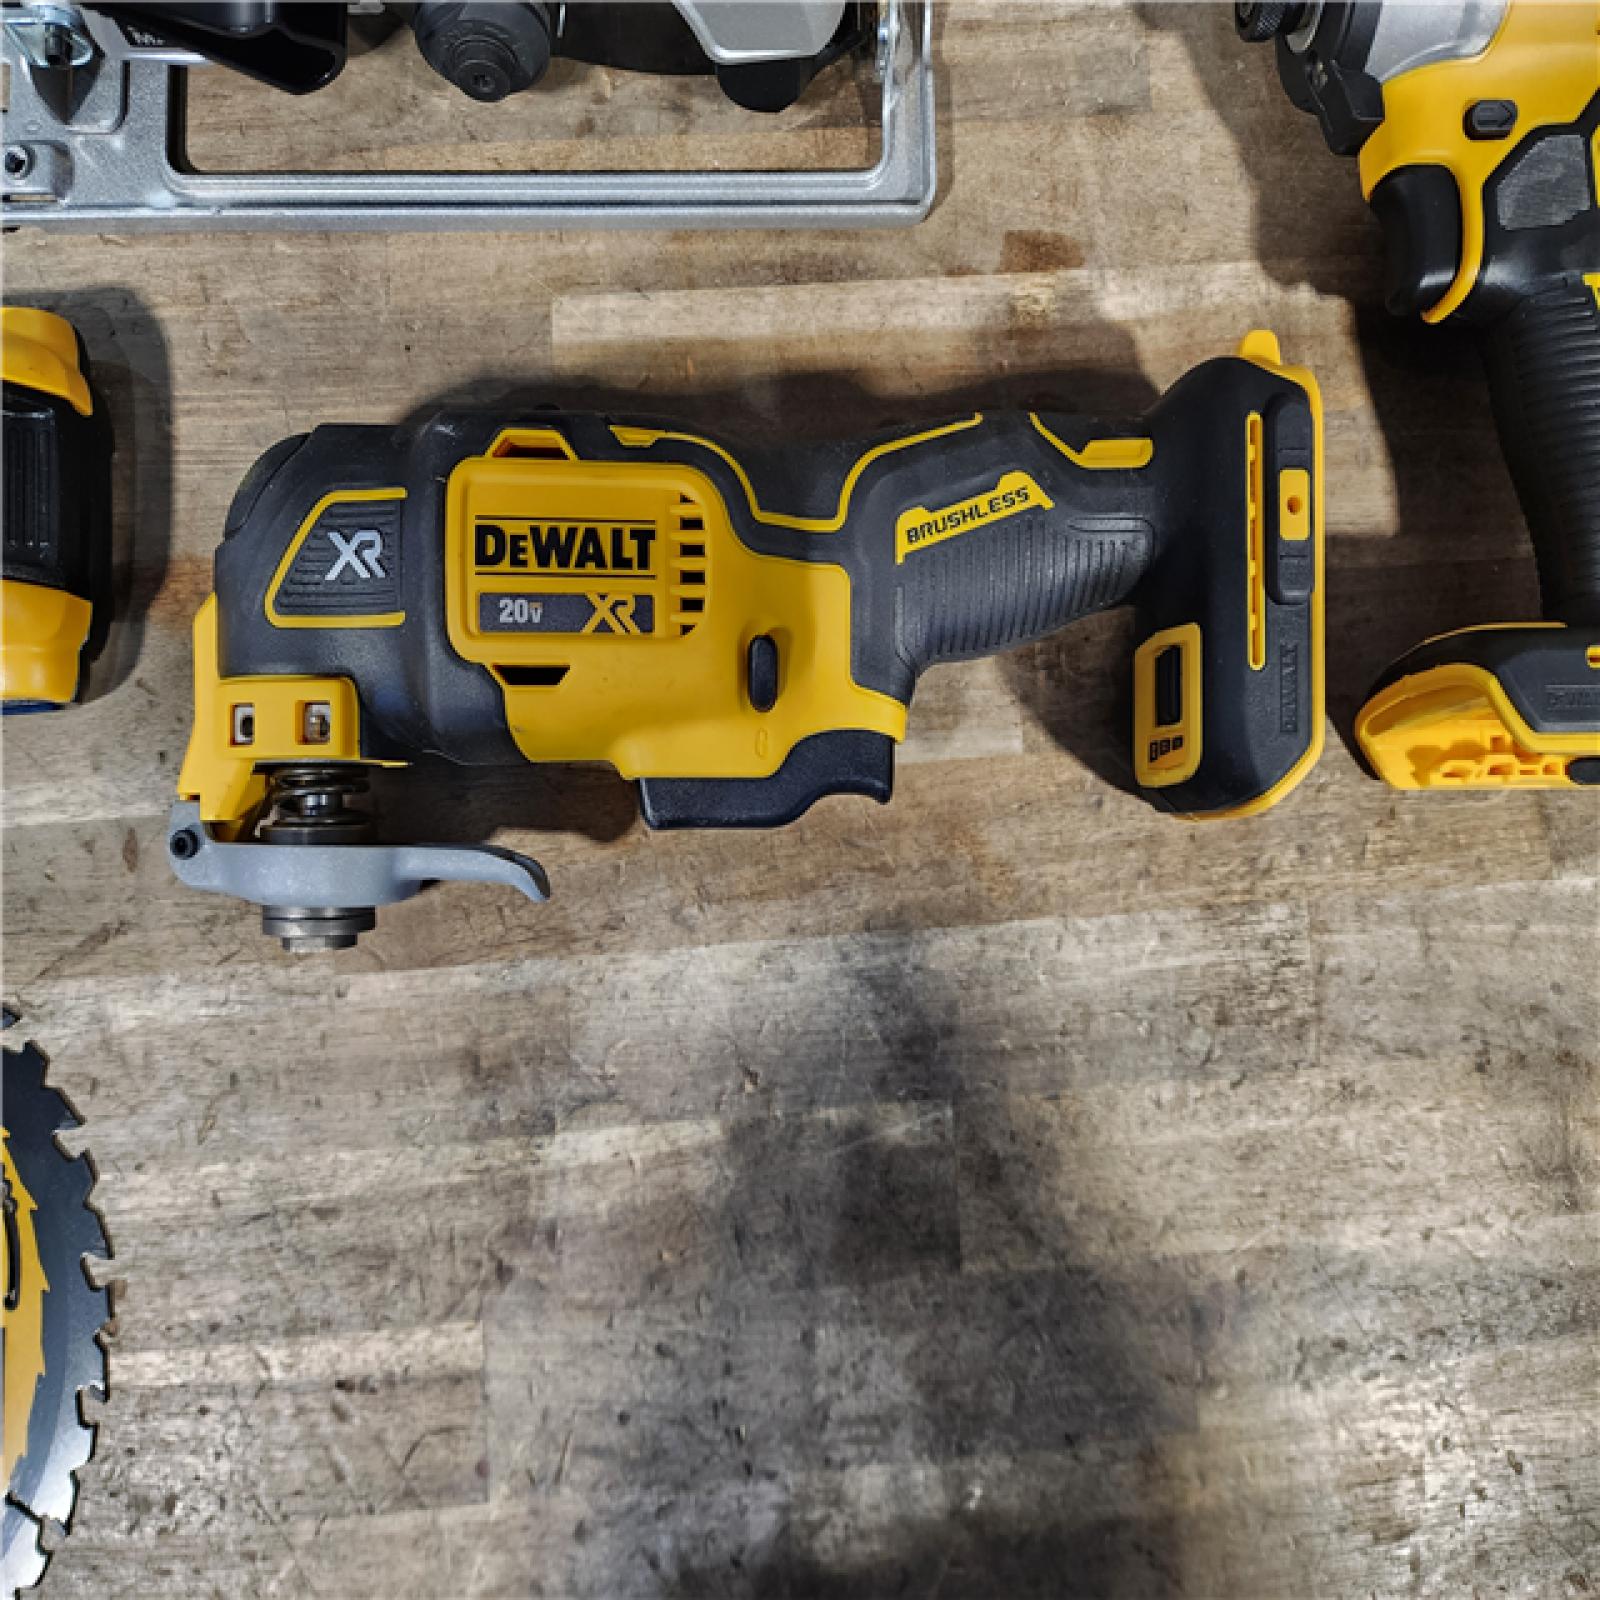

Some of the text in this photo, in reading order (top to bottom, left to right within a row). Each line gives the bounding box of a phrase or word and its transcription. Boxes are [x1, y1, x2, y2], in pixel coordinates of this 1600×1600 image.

[906, 487, 1030, 544] BRUSHLESS
[325, 530, 386, 580] XR
[475, 525, 656, 570] DEWALT
[580, 592, 642, 635] XR
